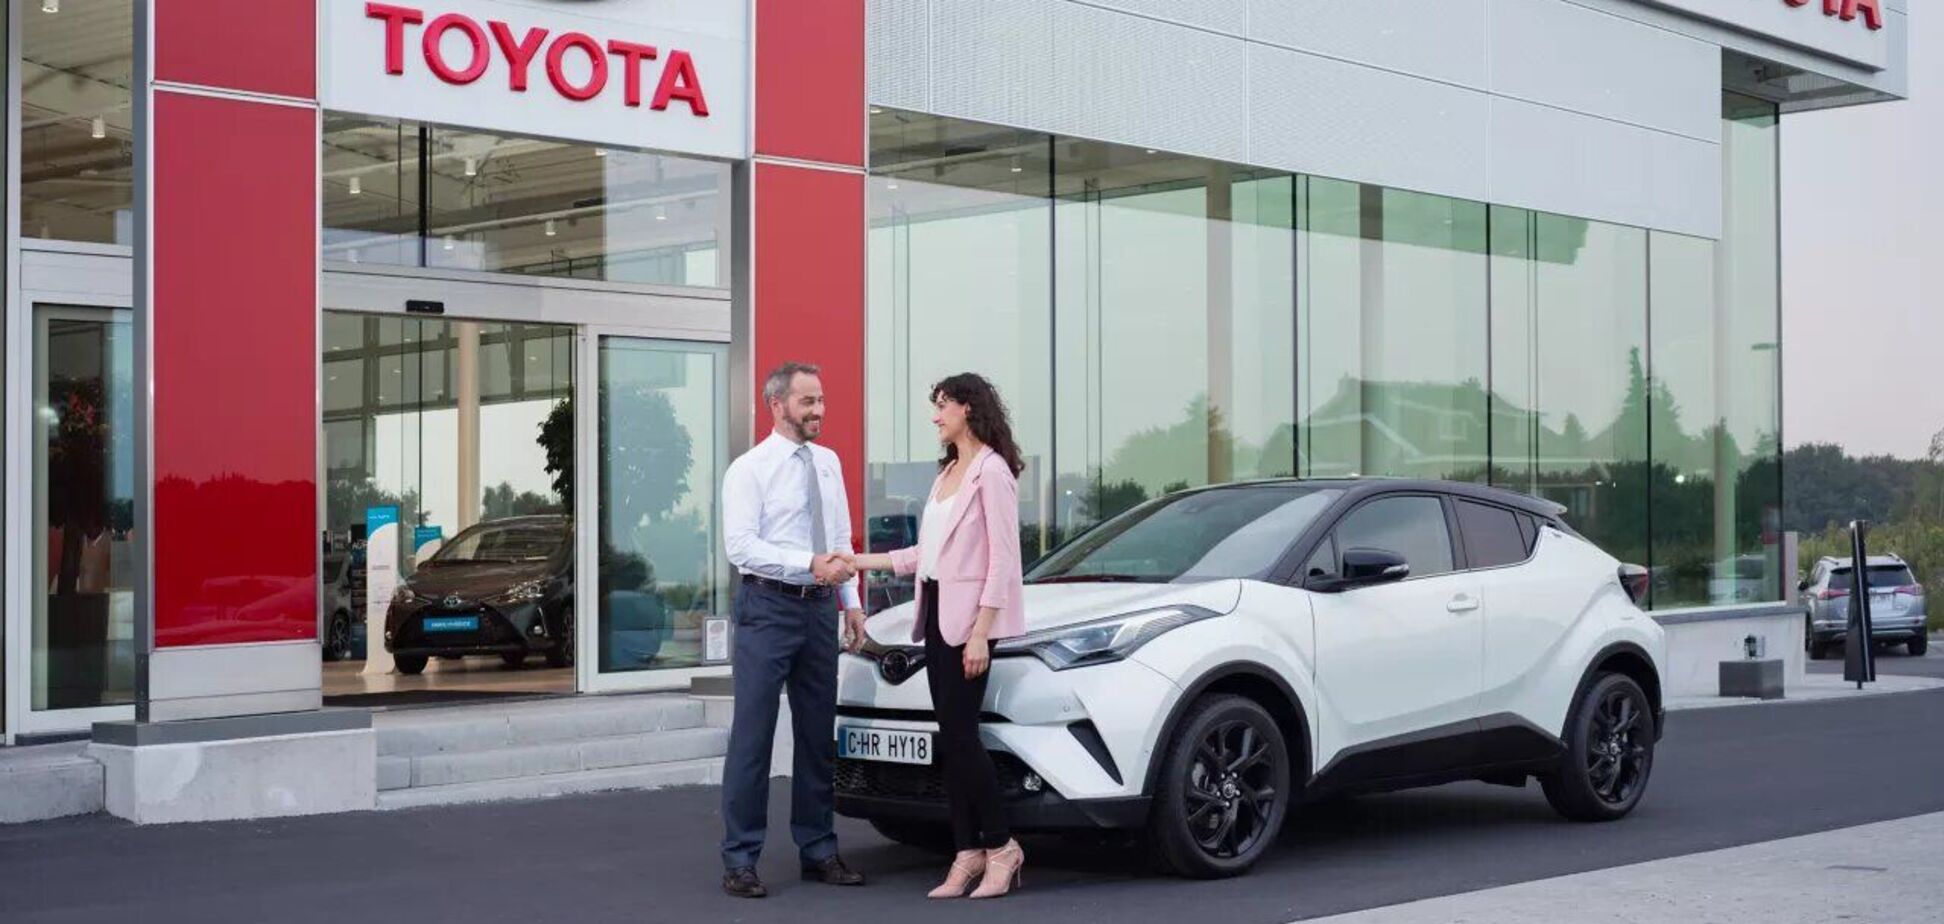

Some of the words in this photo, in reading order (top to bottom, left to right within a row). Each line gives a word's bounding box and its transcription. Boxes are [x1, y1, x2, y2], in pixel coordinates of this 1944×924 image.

[365, 2, 710, 117] TOYOTA
[848, 732, 880, 756] C-HR
[888, 735, 927, 760] HY18
